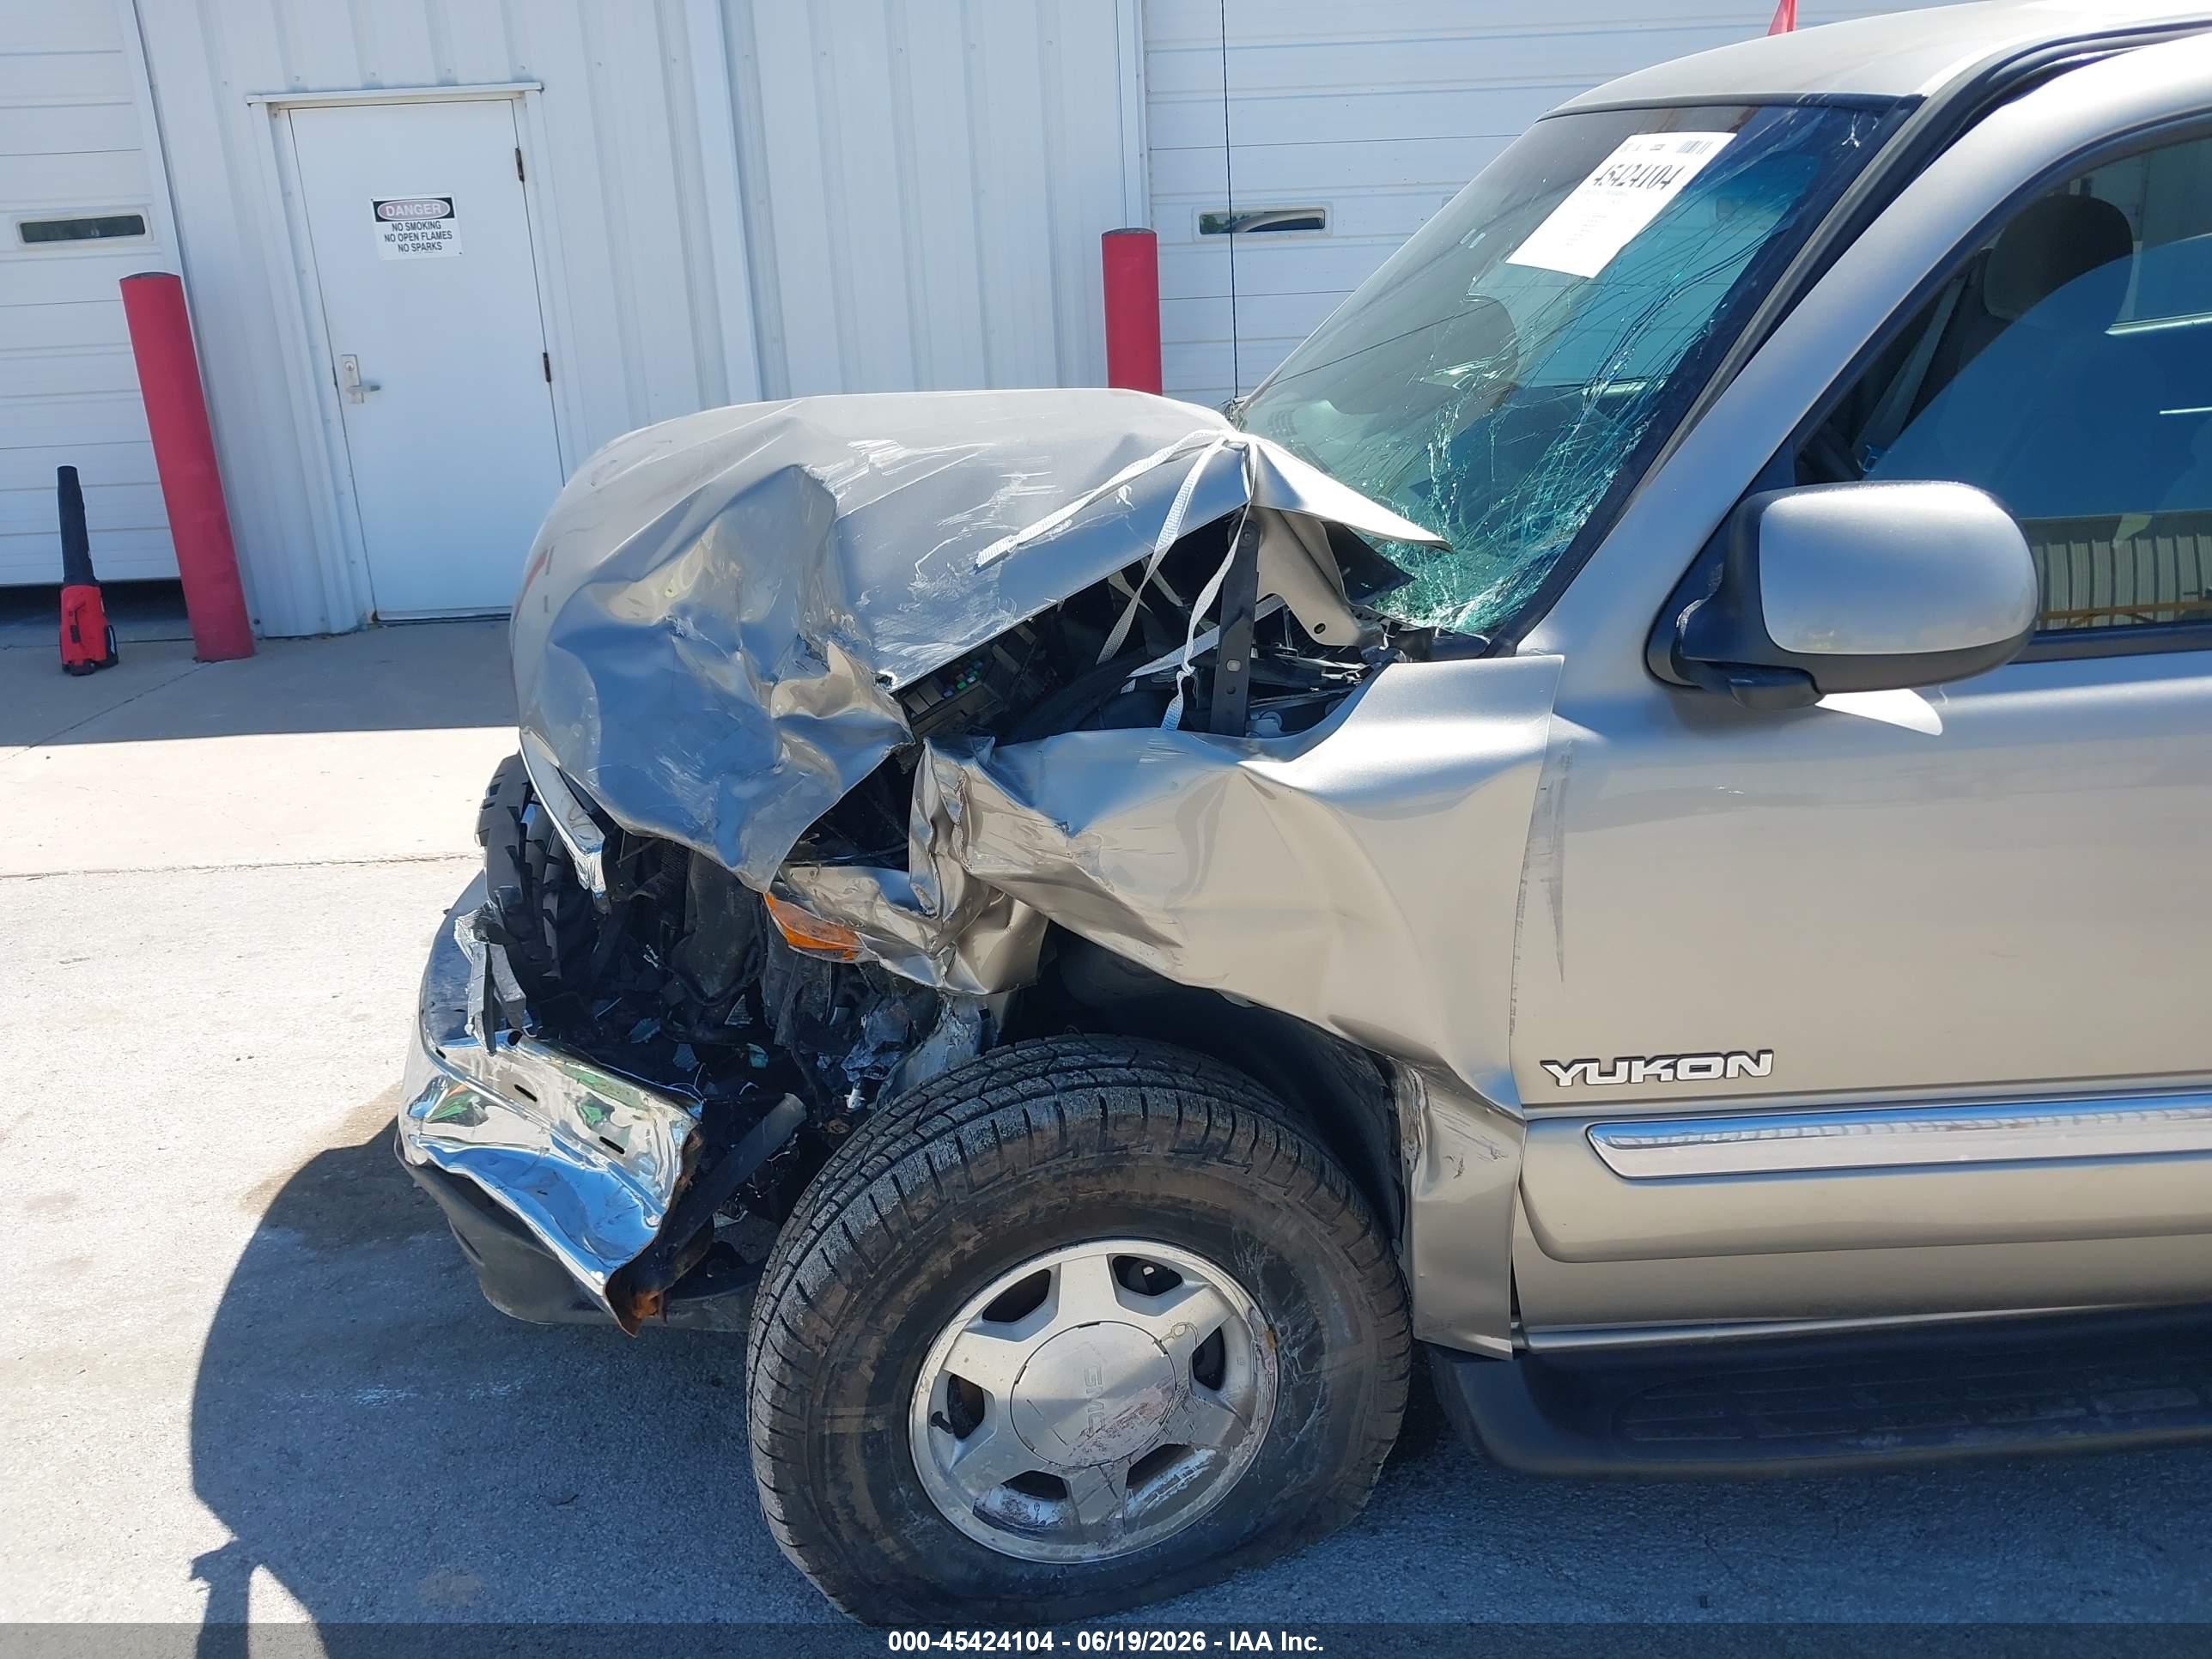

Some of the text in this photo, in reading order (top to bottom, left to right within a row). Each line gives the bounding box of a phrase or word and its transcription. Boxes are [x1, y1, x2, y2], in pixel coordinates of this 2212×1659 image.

[1593, 162, 1687, 191] 45424104
[386, 204, 442, 216] DANGER
[392, 221, 441, 232] NO SMOKING
[384, 230, 453, 242] NO OPEN FLAMES
[398, 241, 442, 252] NO SPARKS
[1540, 1049, 1774, 1088] YUKON
